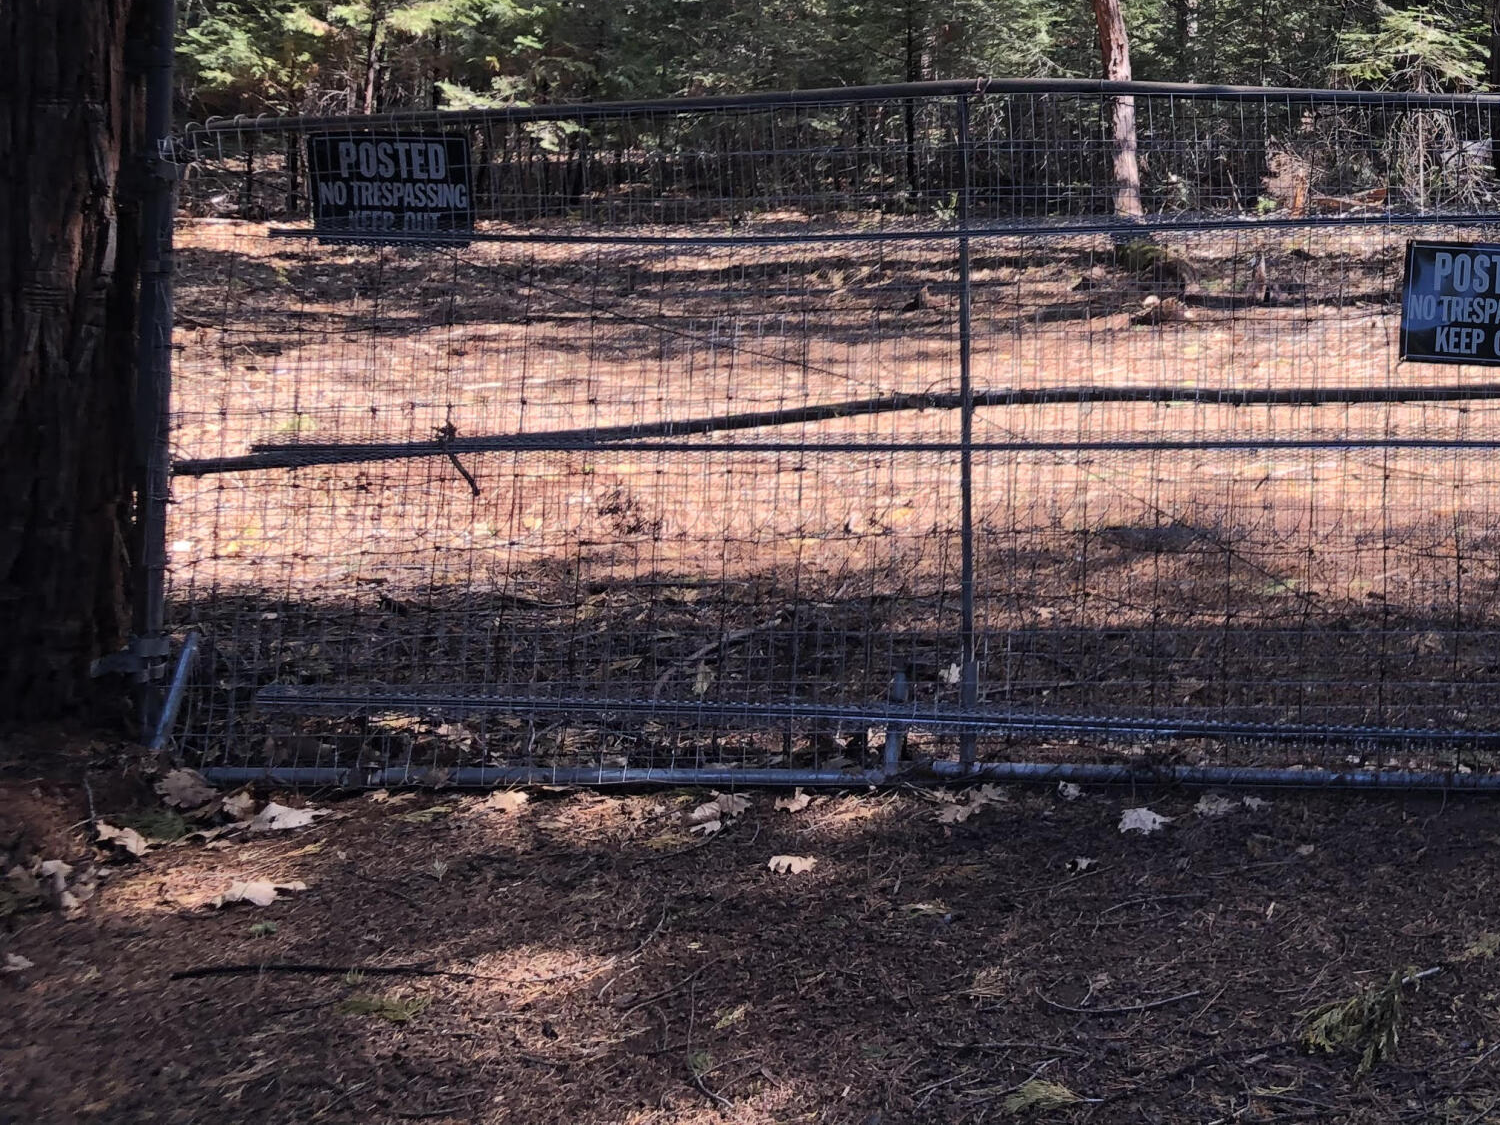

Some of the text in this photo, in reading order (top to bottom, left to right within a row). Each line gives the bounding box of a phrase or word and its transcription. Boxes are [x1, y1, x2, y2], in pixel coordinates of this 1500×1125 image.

[339, 142, 445, 179] POSTED
[320, 182, 467, 207] NO TRESPASSING
[1409, 294, 1435, 320] NO
[1435, 327, 1485, 354] KEEP
